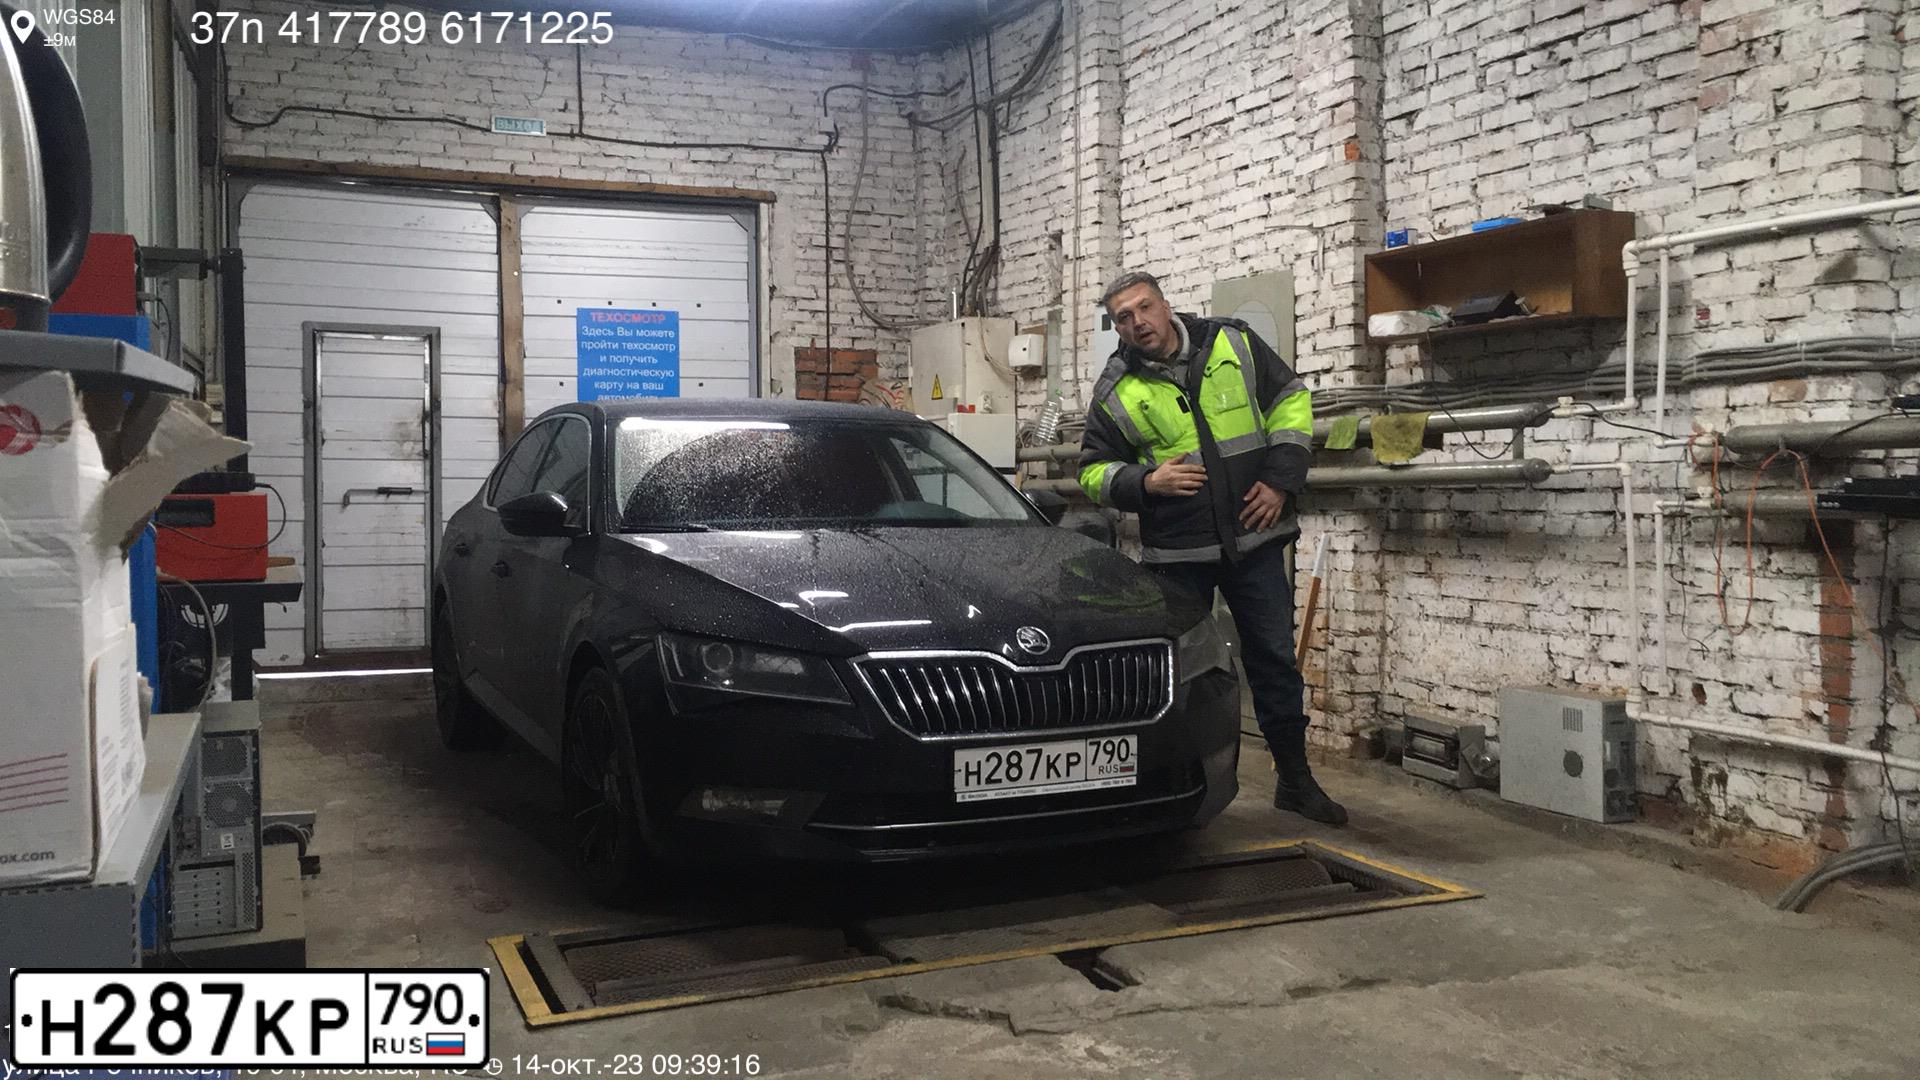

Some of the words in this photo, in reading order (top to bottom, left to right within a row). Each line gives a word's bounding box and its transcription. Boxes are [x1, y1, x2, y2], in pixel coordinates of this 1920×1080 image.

[591, 312, 666, 323] ТЕХОСМОТР
[581, 326, 614, 338] Здесь
[616, 326, 633, 337] Вы
[635, 330, 675, 338] можете
[581, 339, 619, 351] пройти
[622, 342, 676, 353] техосмотр
[600, 355, 607, 363] и
[610, 355, 658, 365] получить
[583, 368, 675, 379] диагностическую
[594, 381, 624, 392] карту
[626, 382, 640, 390] на
[642, 382, 664, 391] ваш
[964, 747, 1082, 788] Н287КР
[1088, 738, 1130, 766] 790
[1098, 763, 1120, 776] RUS
